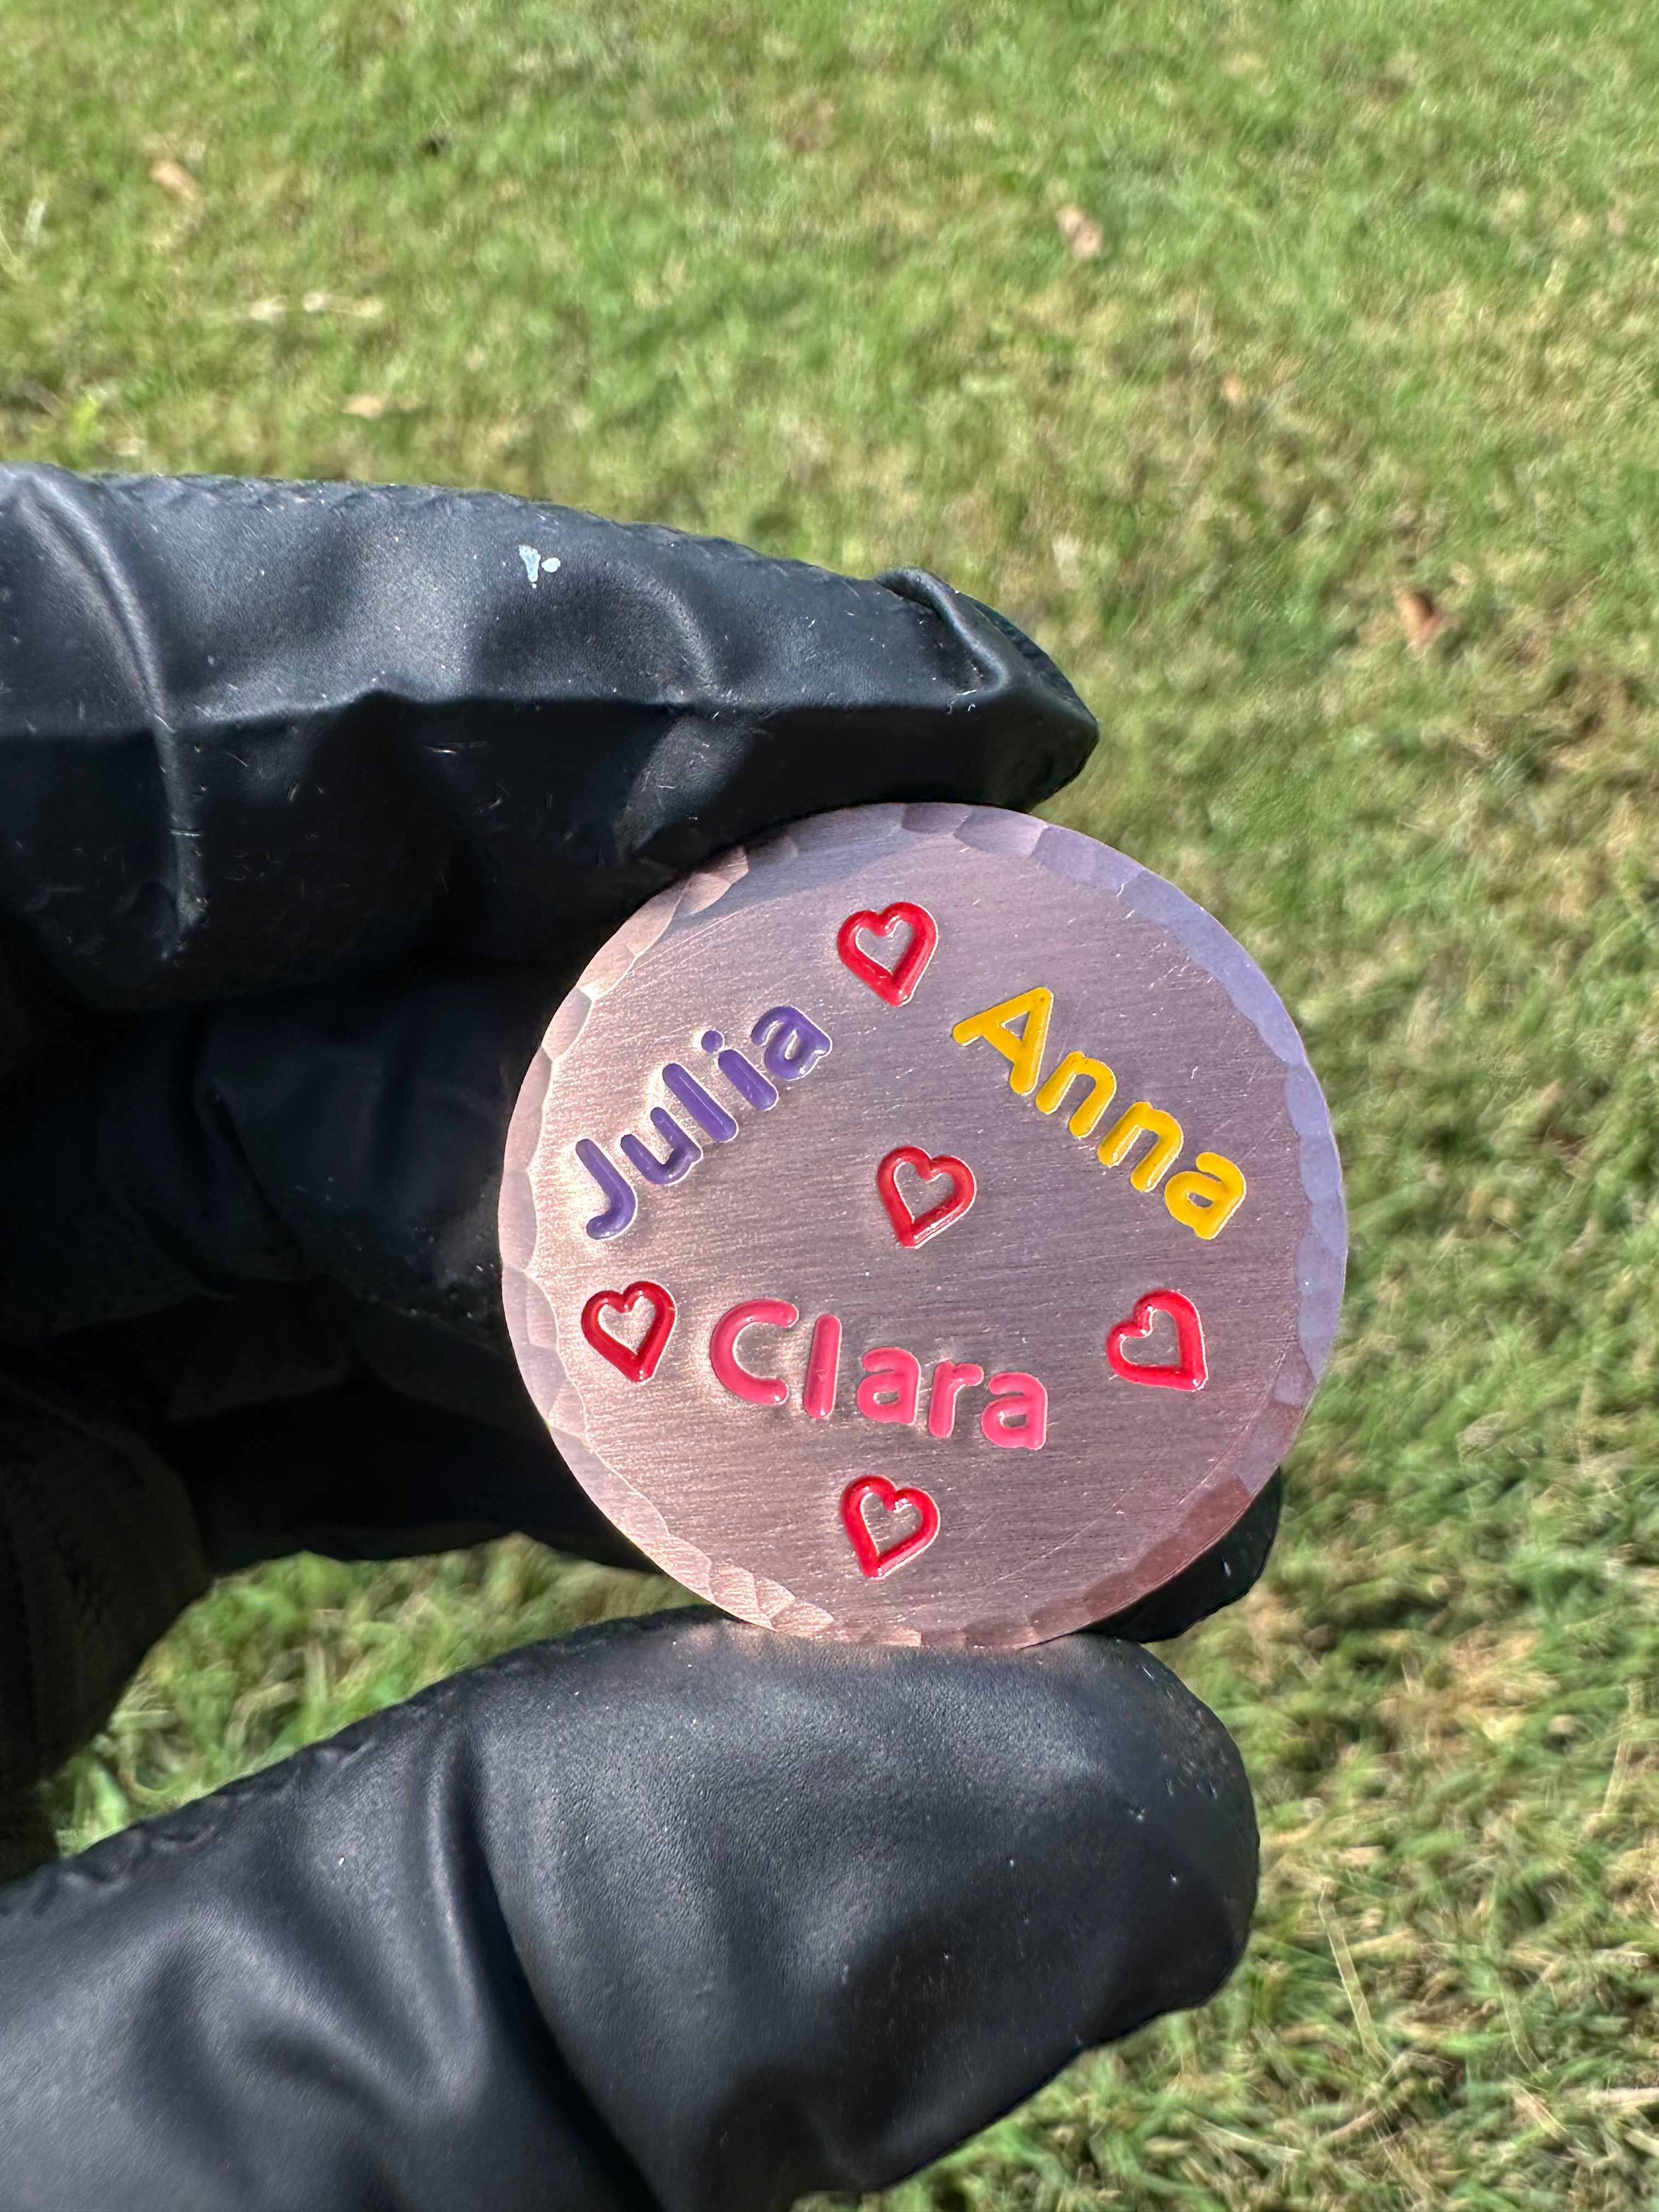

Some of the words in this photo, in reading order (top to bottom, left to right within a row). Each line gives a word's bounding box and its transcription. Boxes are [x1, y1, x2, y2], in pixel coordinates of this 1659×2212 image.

[574, 1006, 832, 1240] Julia
[952, 987, 1246, 1239] Anna
[709, 1299, 1048, 1450] Clara
